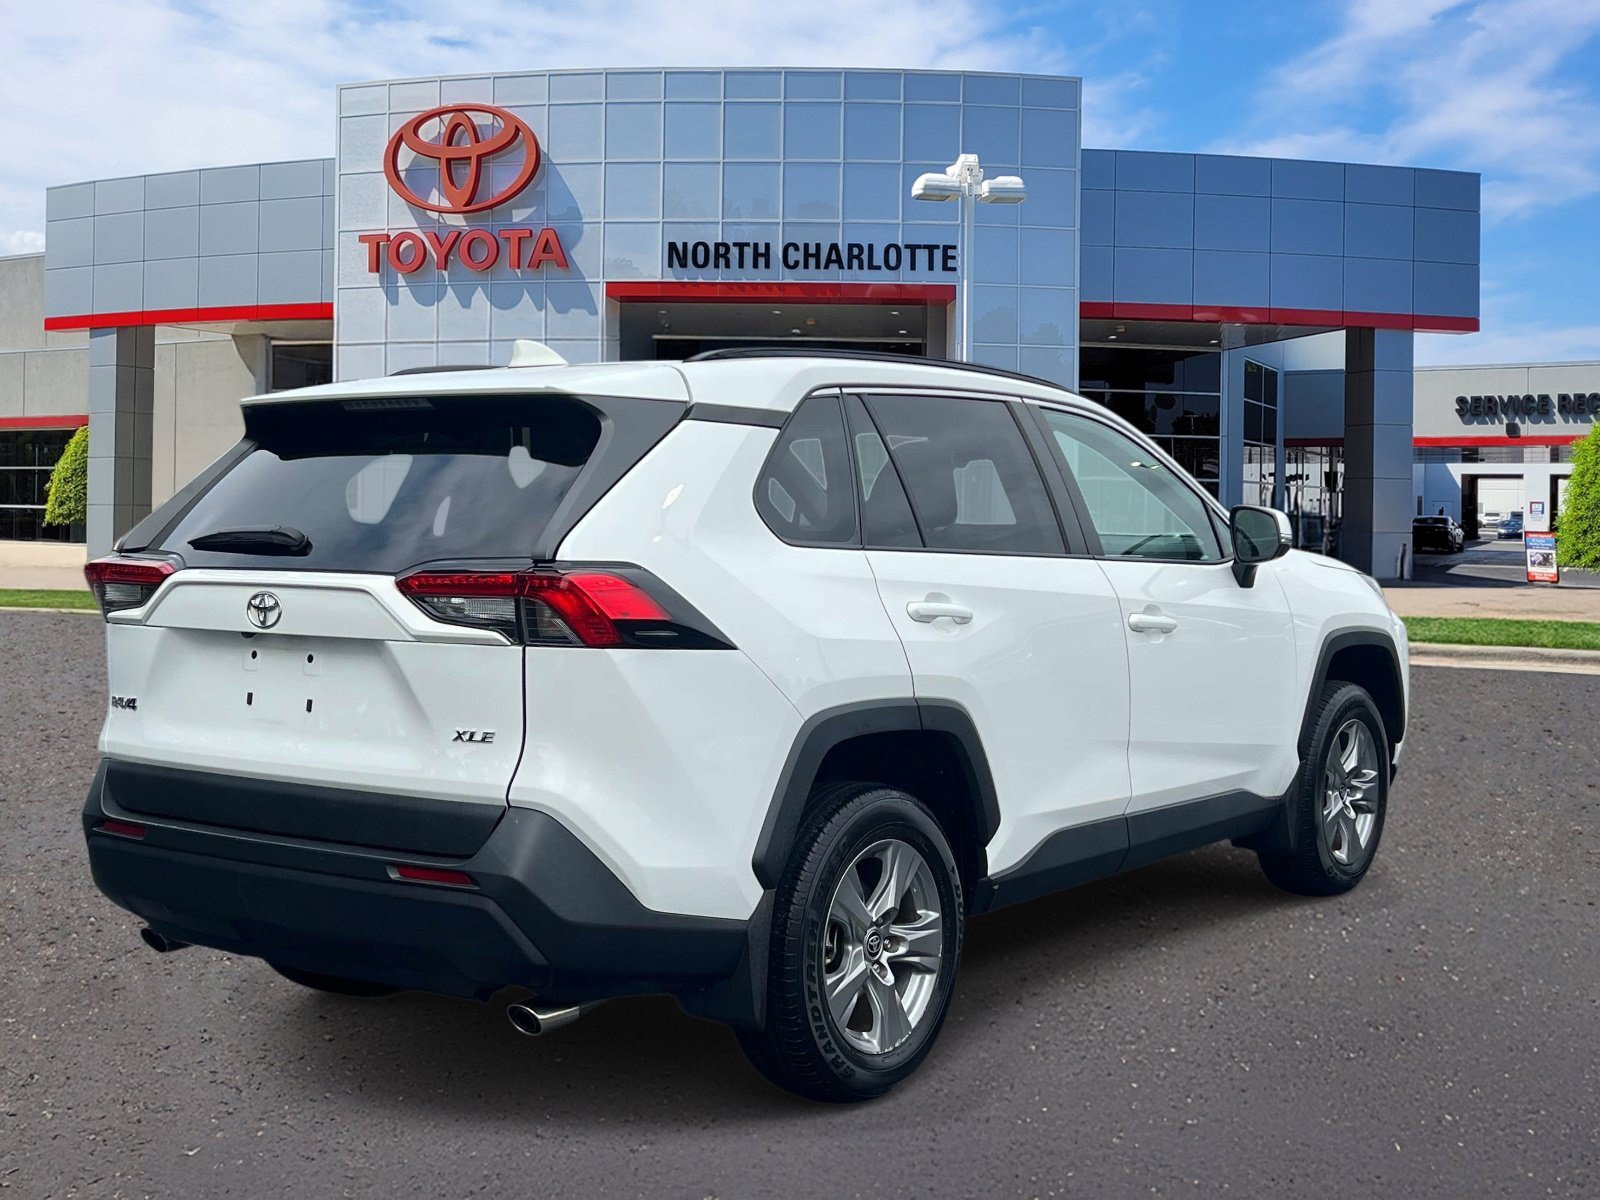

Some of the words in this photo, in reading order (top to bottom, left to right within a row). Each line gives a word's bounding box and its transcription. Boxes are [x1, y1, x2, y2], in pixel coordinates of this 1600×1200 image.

[358, 228, 569, 274] TOYOTA
[667, 241, 771, 269] NORTH
[782, 242, 958, 272] CHARLOTTE
[1455, 394, 1551, 417] SERVICE
[452, 730, 496, 744] XLE
